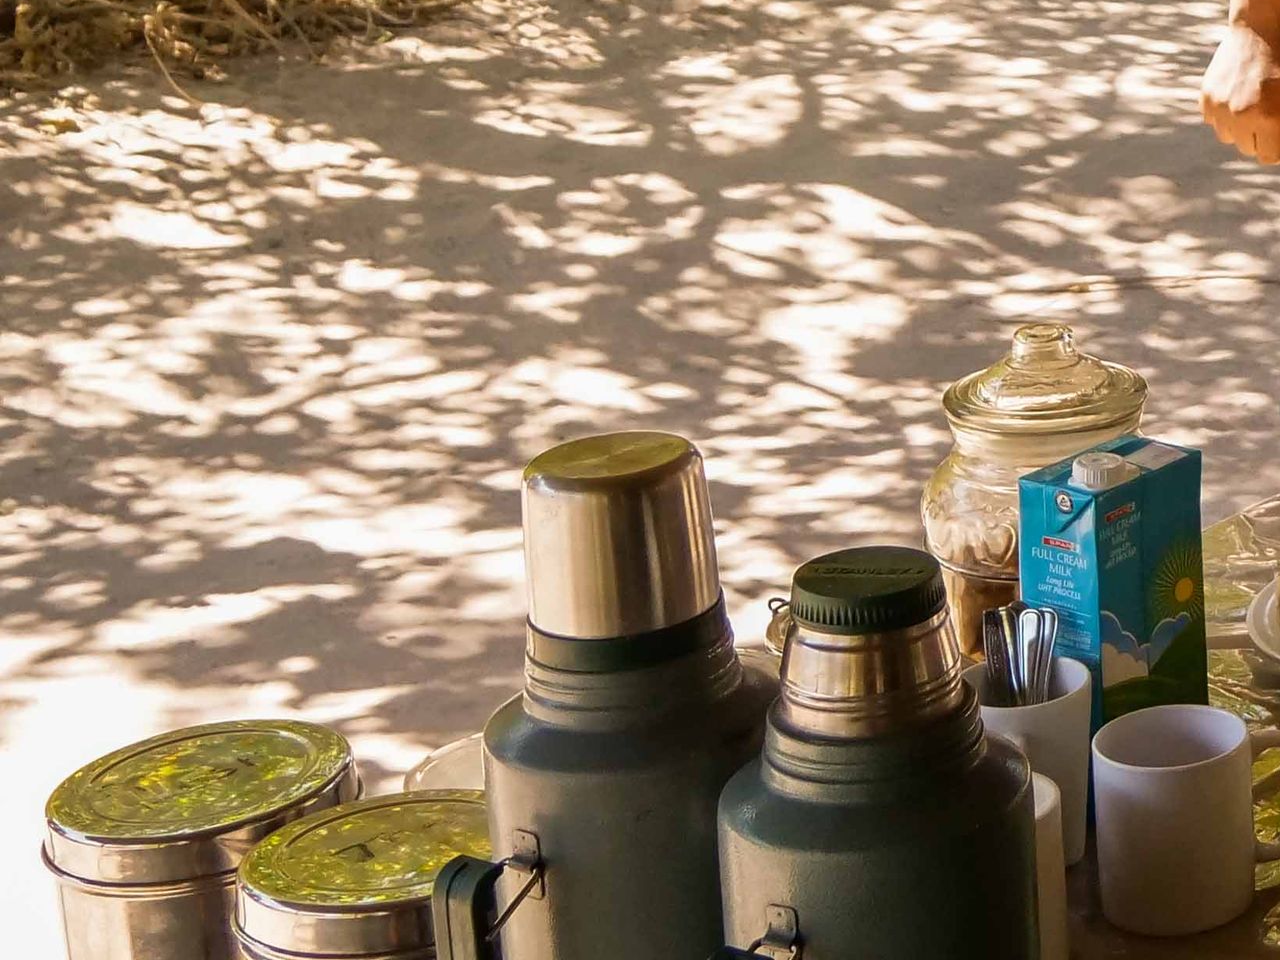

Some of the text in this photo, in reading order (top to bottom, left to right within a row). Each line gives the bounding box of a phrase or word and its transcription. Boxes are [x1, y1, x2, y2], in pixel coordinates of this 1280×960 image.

[1031, 546, 1054, 561] FULL
[1056, 552, 1087, 570] CREAM
[1048, 562, 1073, 577] MILK
